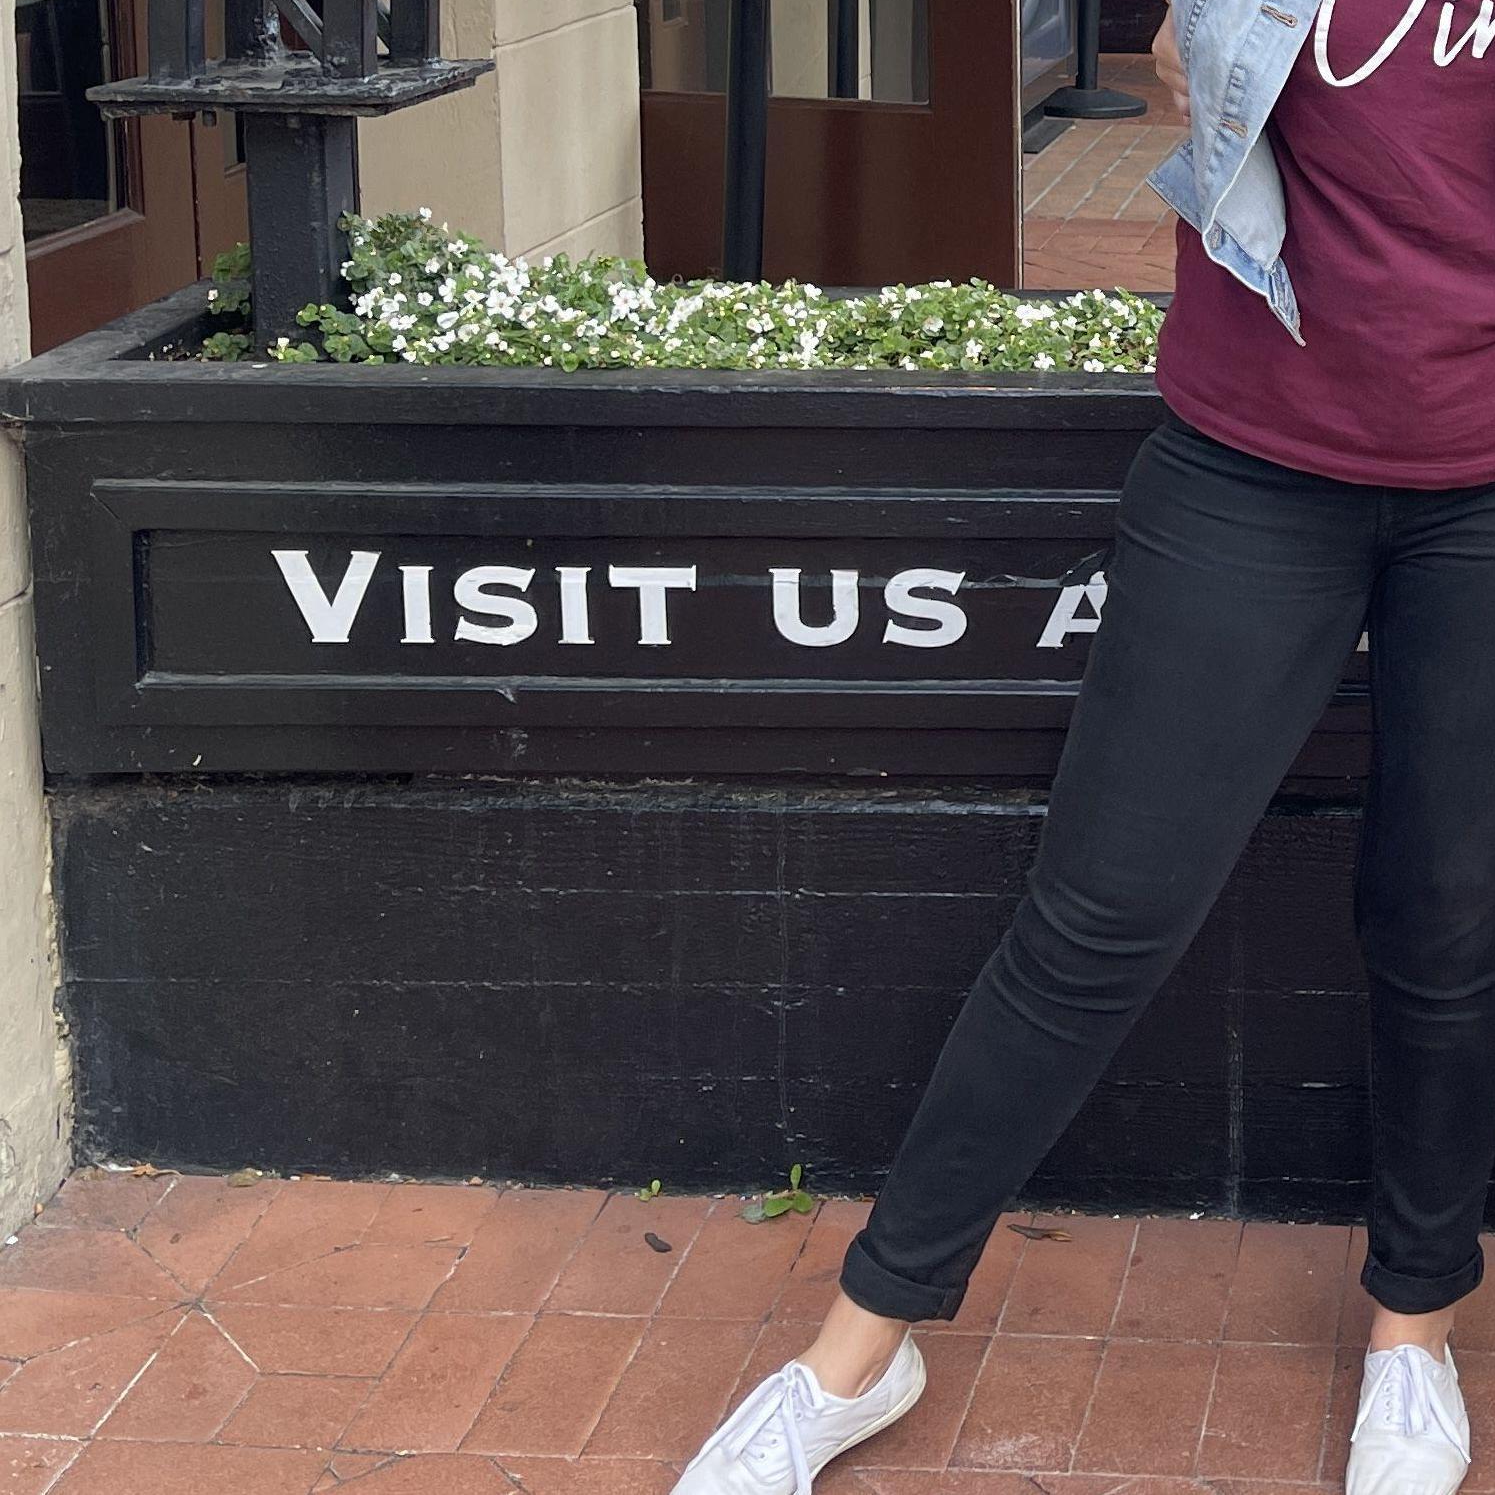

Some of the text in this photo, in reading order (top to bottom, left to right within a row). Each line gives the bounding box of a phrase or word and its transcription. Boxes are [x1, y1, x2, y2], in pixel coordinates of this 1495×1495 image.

[271, 549, 697, 645] VISIT
[768, 566, 970, 648] US
[1036, 569, 1108, 648] A
